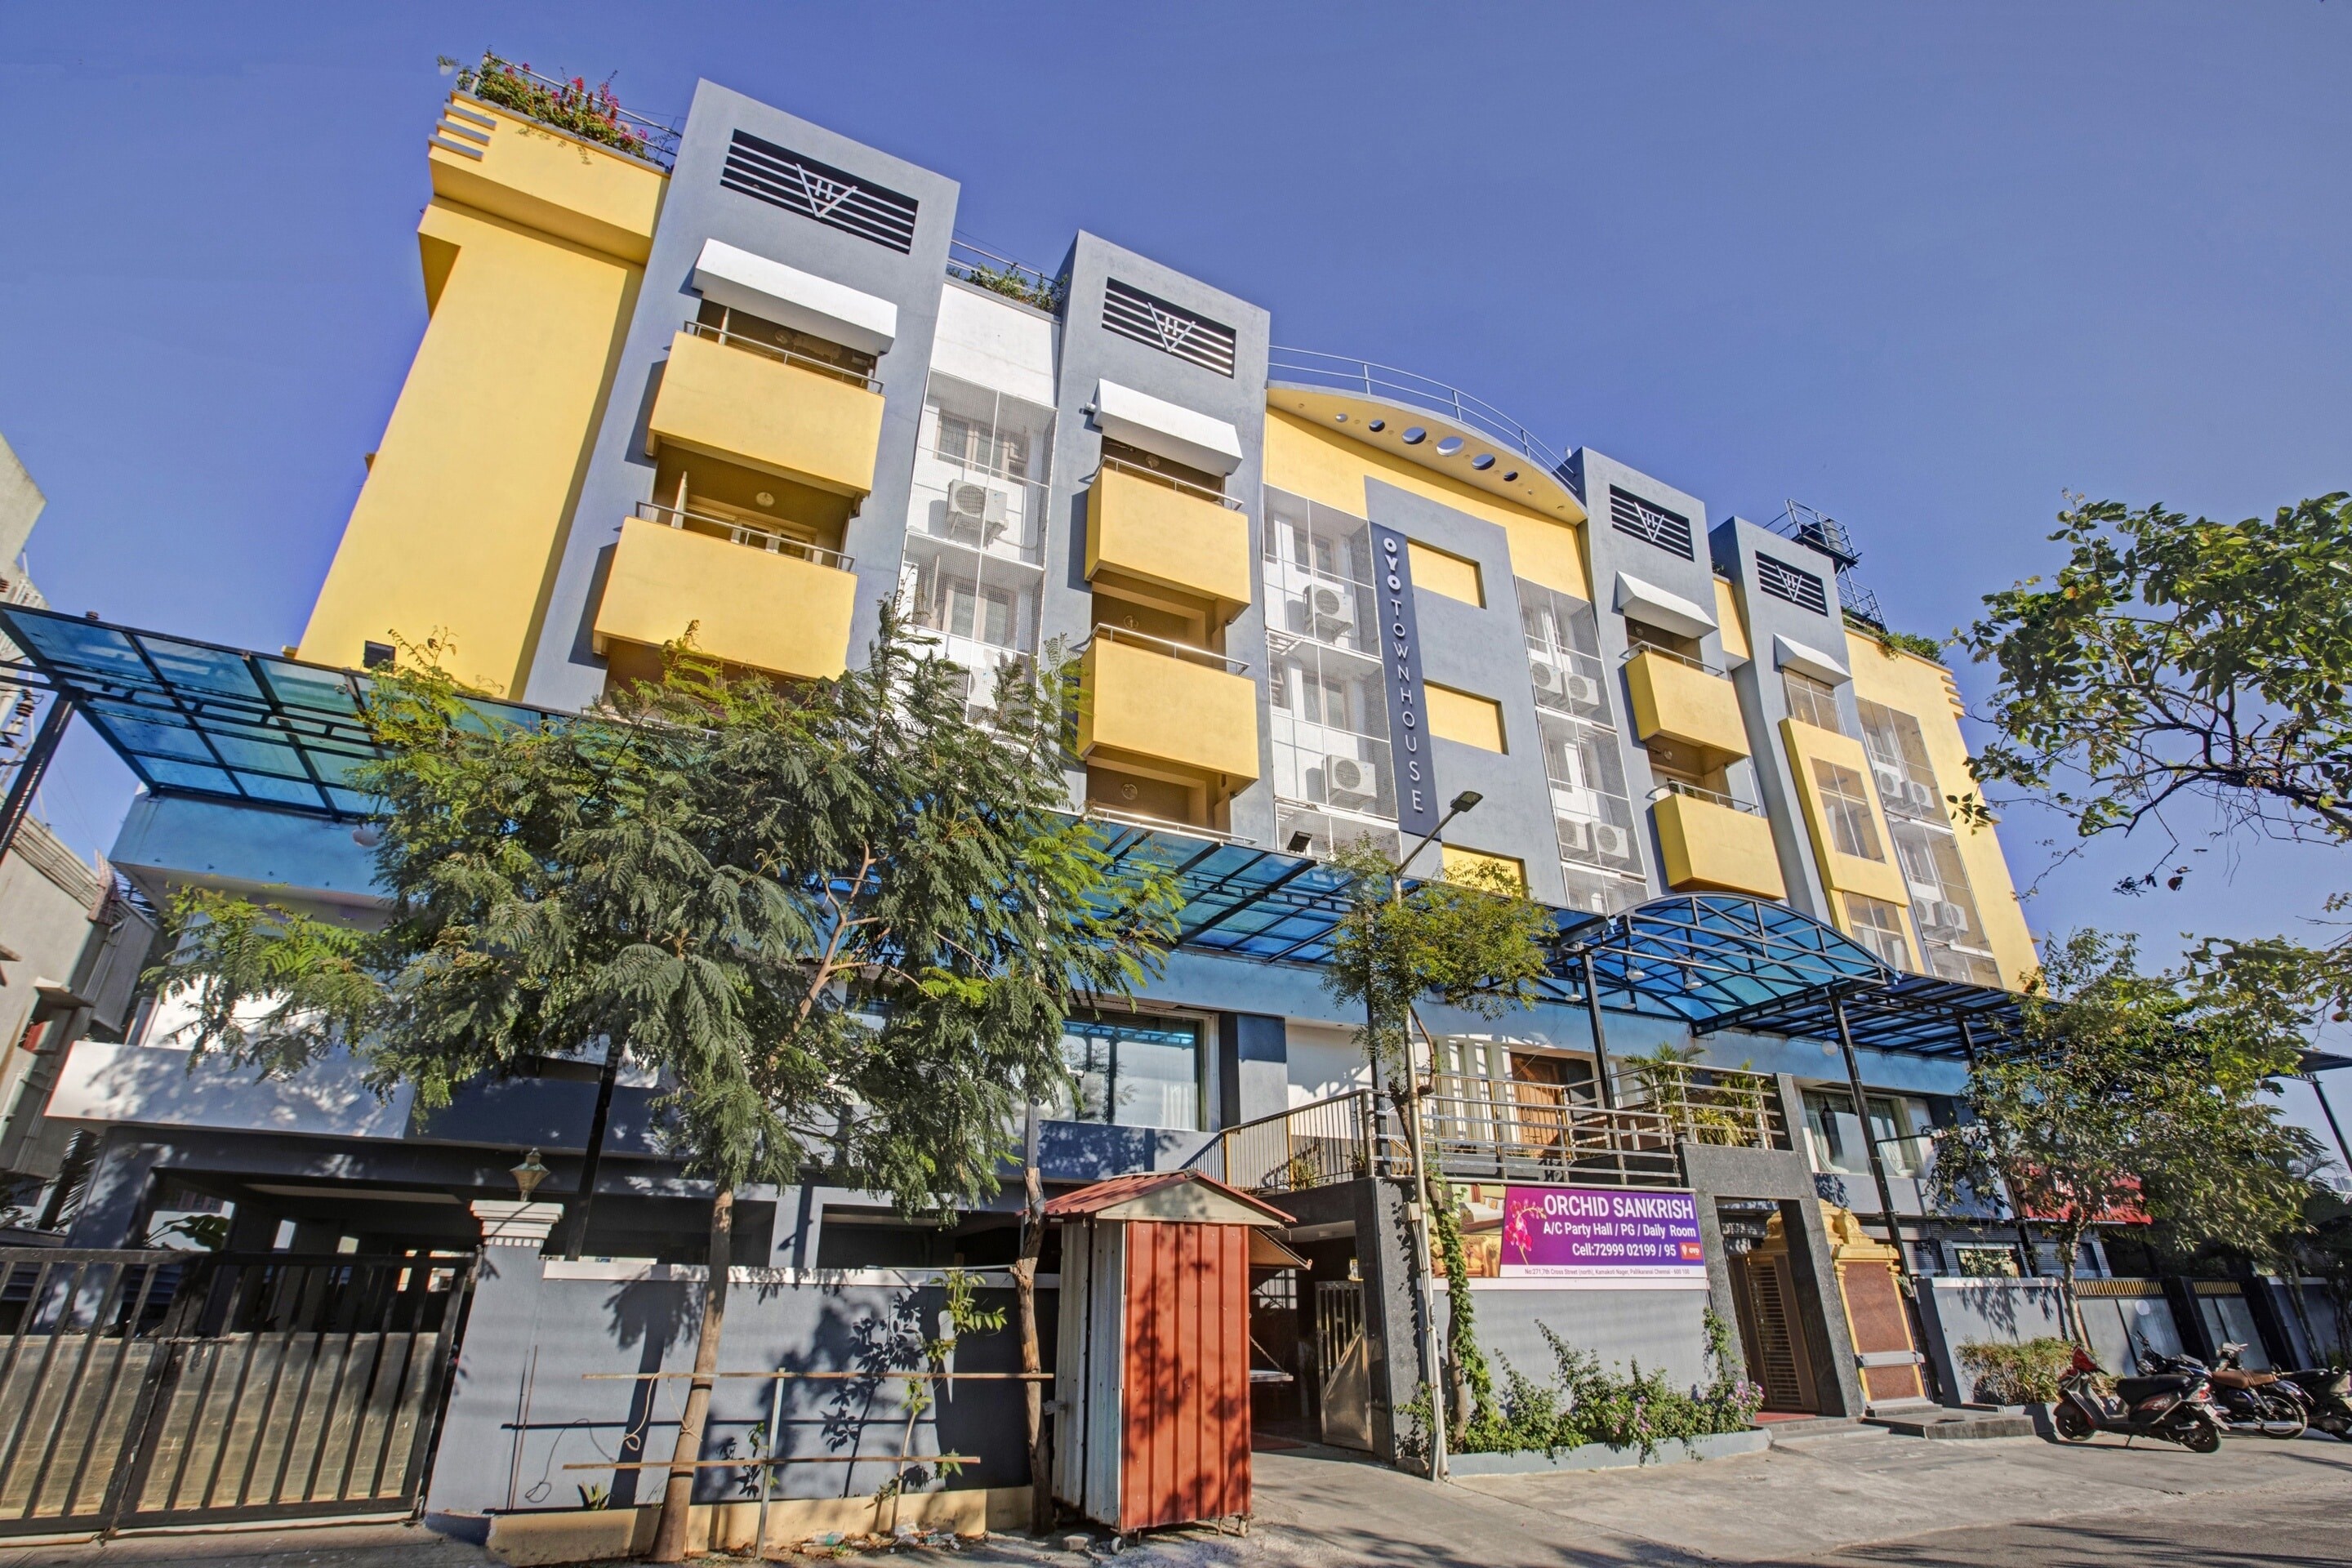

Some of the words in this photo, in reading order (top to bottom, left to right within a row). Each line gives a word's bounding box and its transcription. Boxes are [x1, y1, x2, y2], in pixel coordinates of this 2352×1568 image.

[1383, 537, 1401, 590] OYO
[1391, 599, 1423, 812] TOWNHOUSE
[1544, 1194, 1610, 1217] ORCHID
[1613, 1196, 1695, 1219] SANKRISH
[1544, 1221, 1563, 1235] A/C
[1565, 1222, 1591, 1238] Party
[1592, 1223, 1613, 1236] Hall
[1615, 1223, 1619, 1236] /
[1620, 1223, 1635, 1236] PG
[1637, 1224, 1641, 1237] /
[1643, 1223, 1665, 1240] Daily
[1669, 1224, 1696, 1237] Room
[1572, 1242, 1624, 1256] Cell:72999
[1627, 1243, 1656, 1257] 02199
[1659, 1244, 1662, 1258] /
[1664, 1244, 1677, 1257] 95
